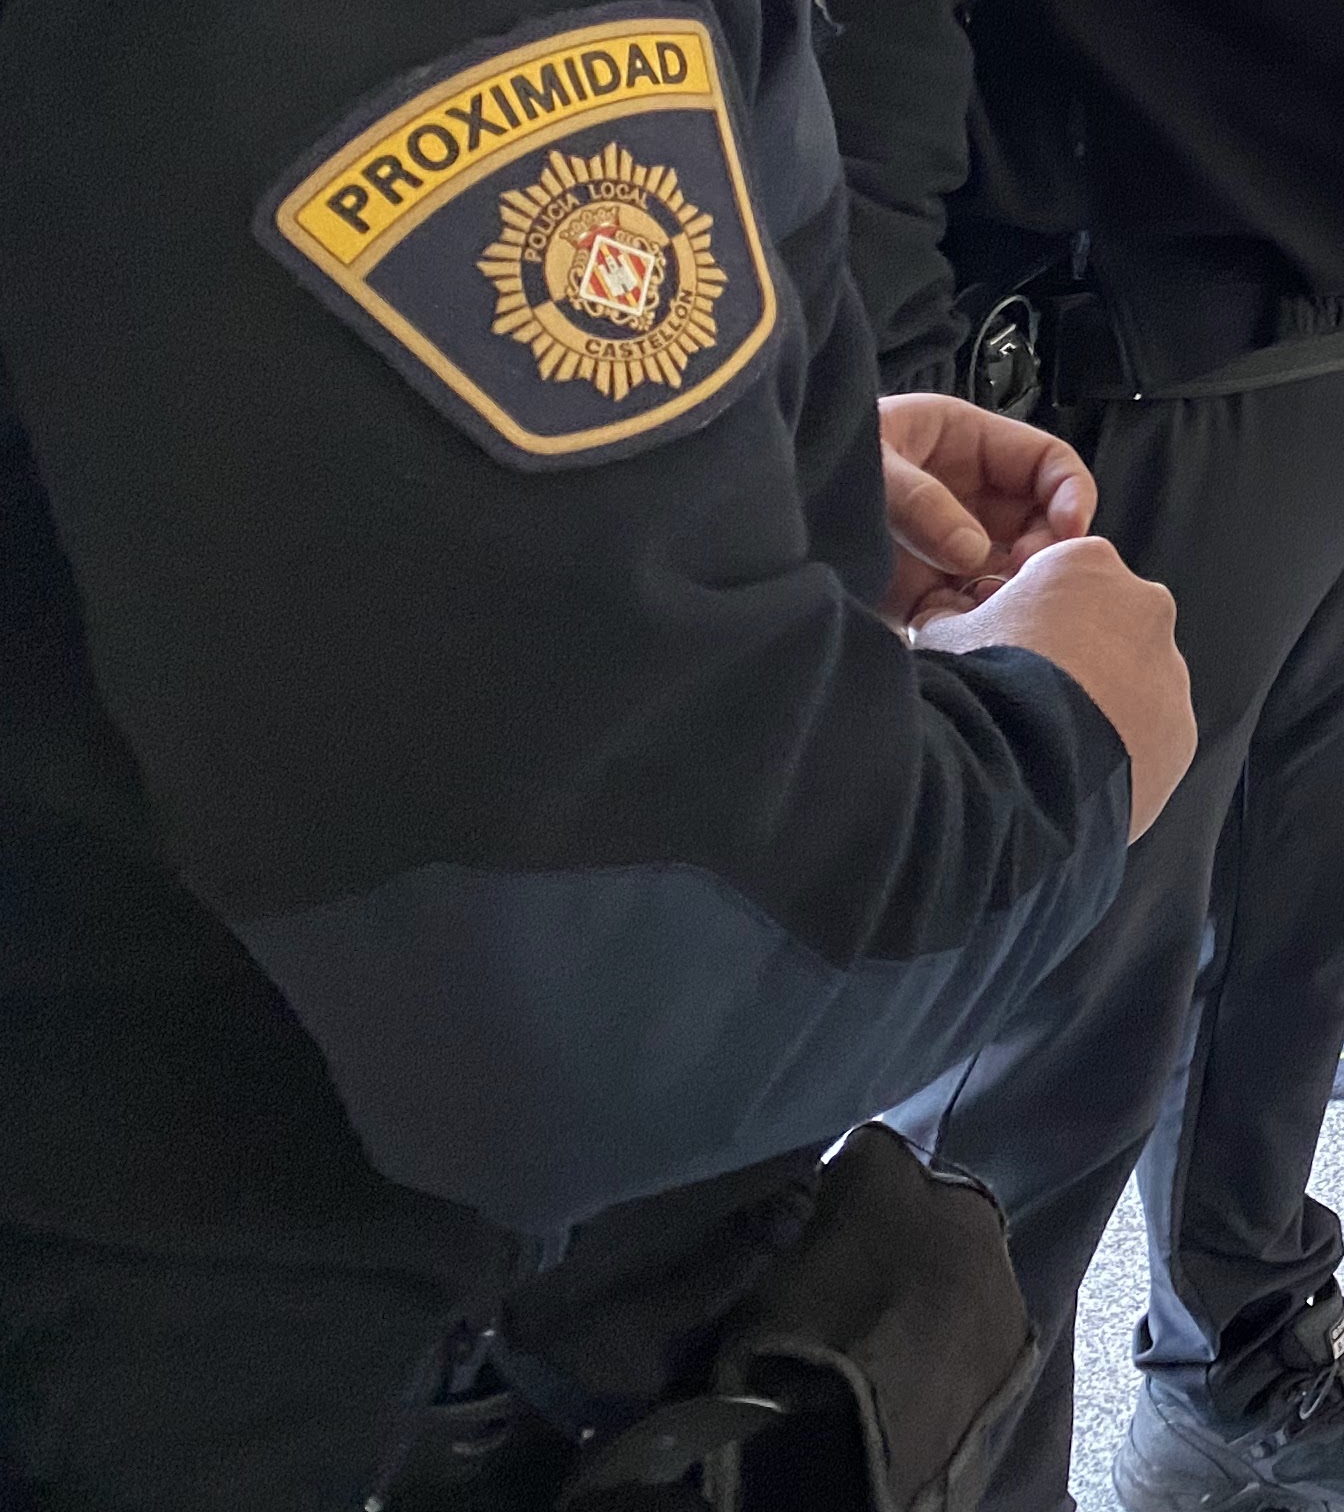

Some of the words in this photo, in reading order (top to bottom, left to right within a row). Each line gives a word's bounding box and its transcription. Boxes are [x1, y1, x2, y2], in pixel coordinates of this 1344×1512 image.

[326, 41, 688, 234] PROXIMIDAD
[524, 193, 580, 263] POLICIA
[588, 181, 649, 210] LOCAL
